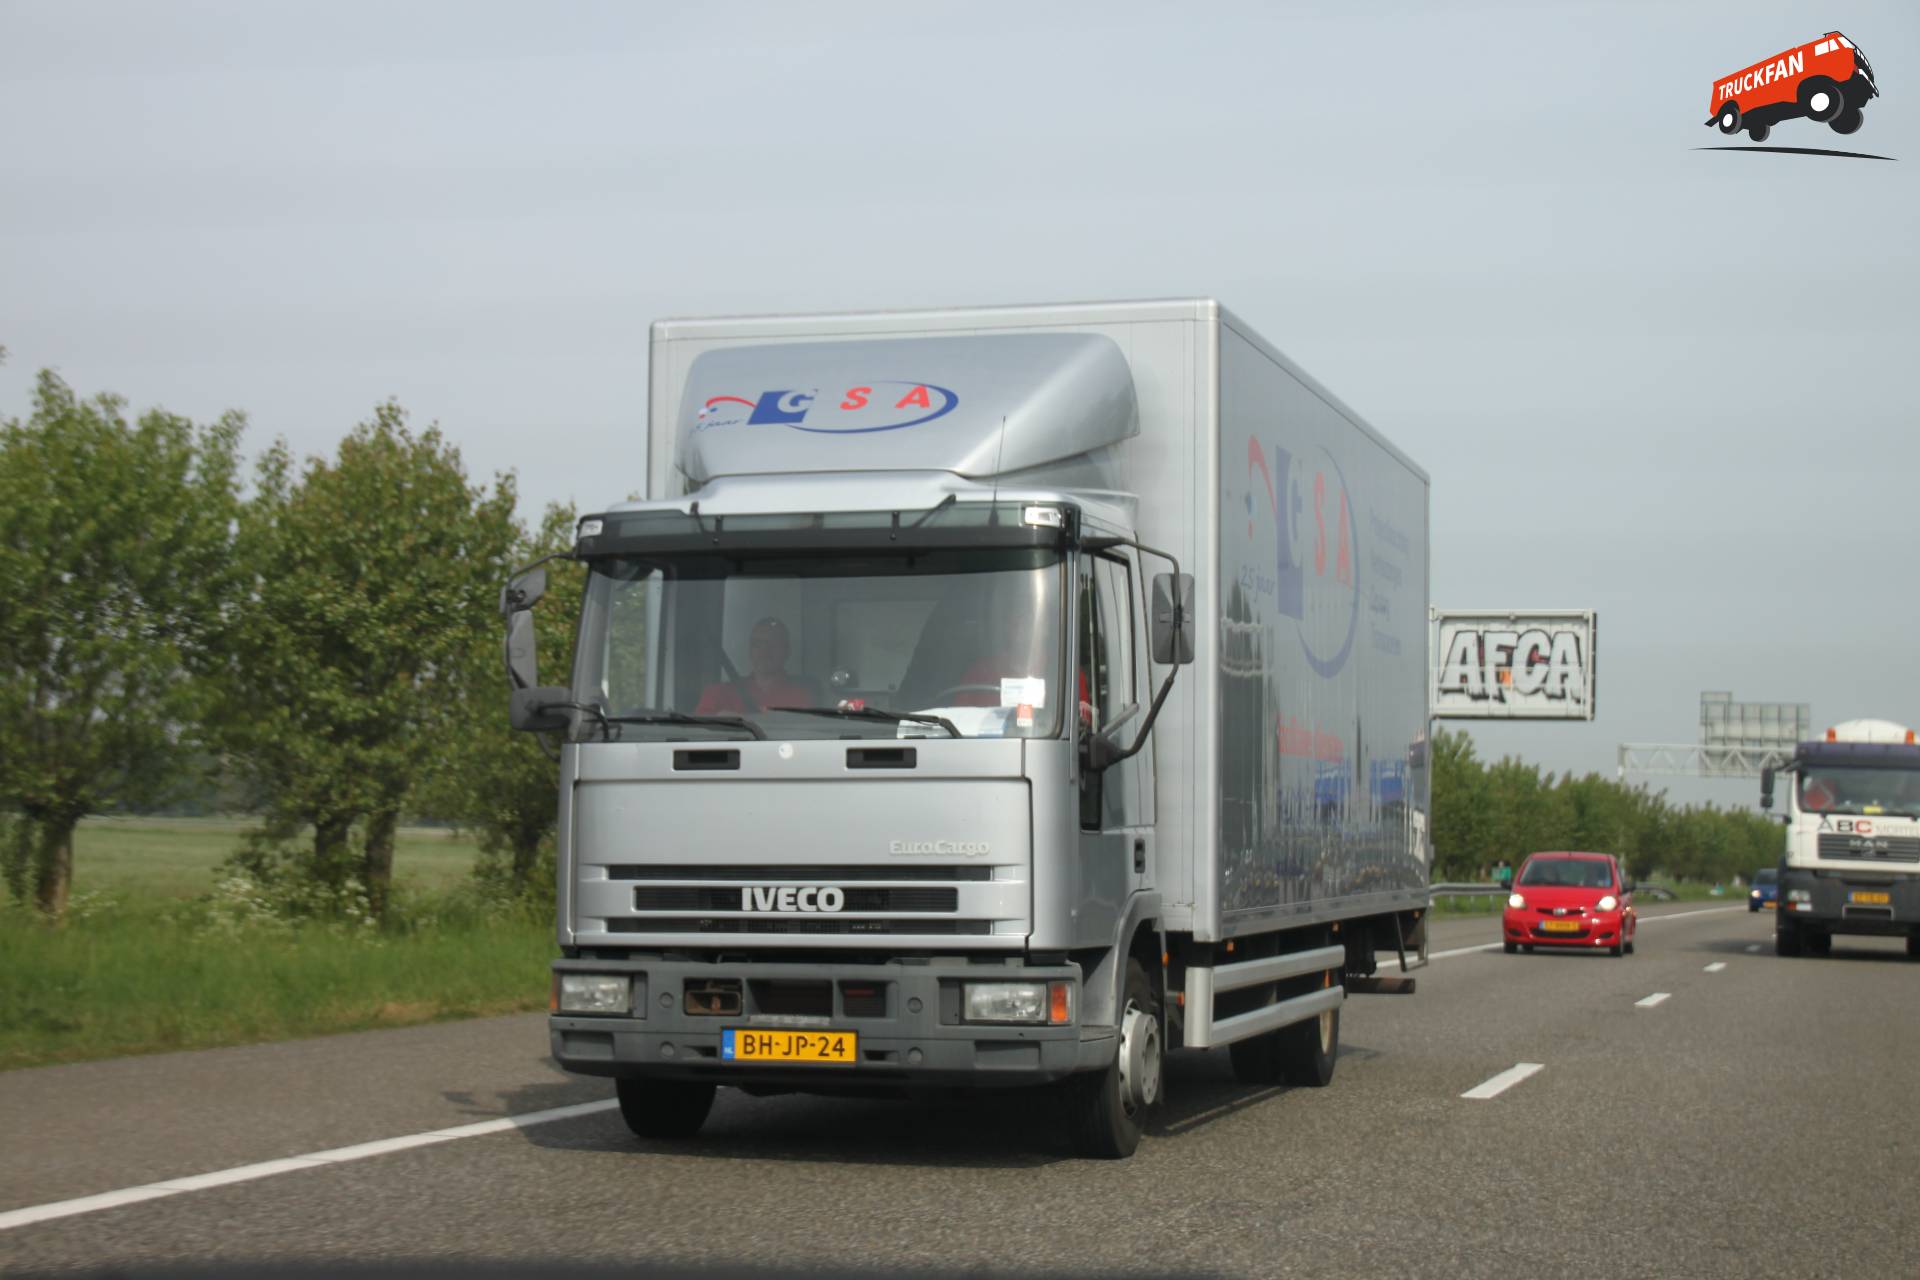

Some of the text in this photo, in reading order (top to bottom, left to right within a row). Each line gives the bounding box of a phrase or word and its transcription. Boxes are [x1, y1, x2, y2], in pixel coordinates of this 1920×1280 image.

[1440, 628, 1587, 705] AFCA
[1818, 818, 1872, 833] ABC
[889, 840, 991, 857] EuroCargo
[1849, 839, 1889, 849] MAN
[741, 887, 845, 911] IVECO
[743, 1034, 846, 1057] BH-JP-24
